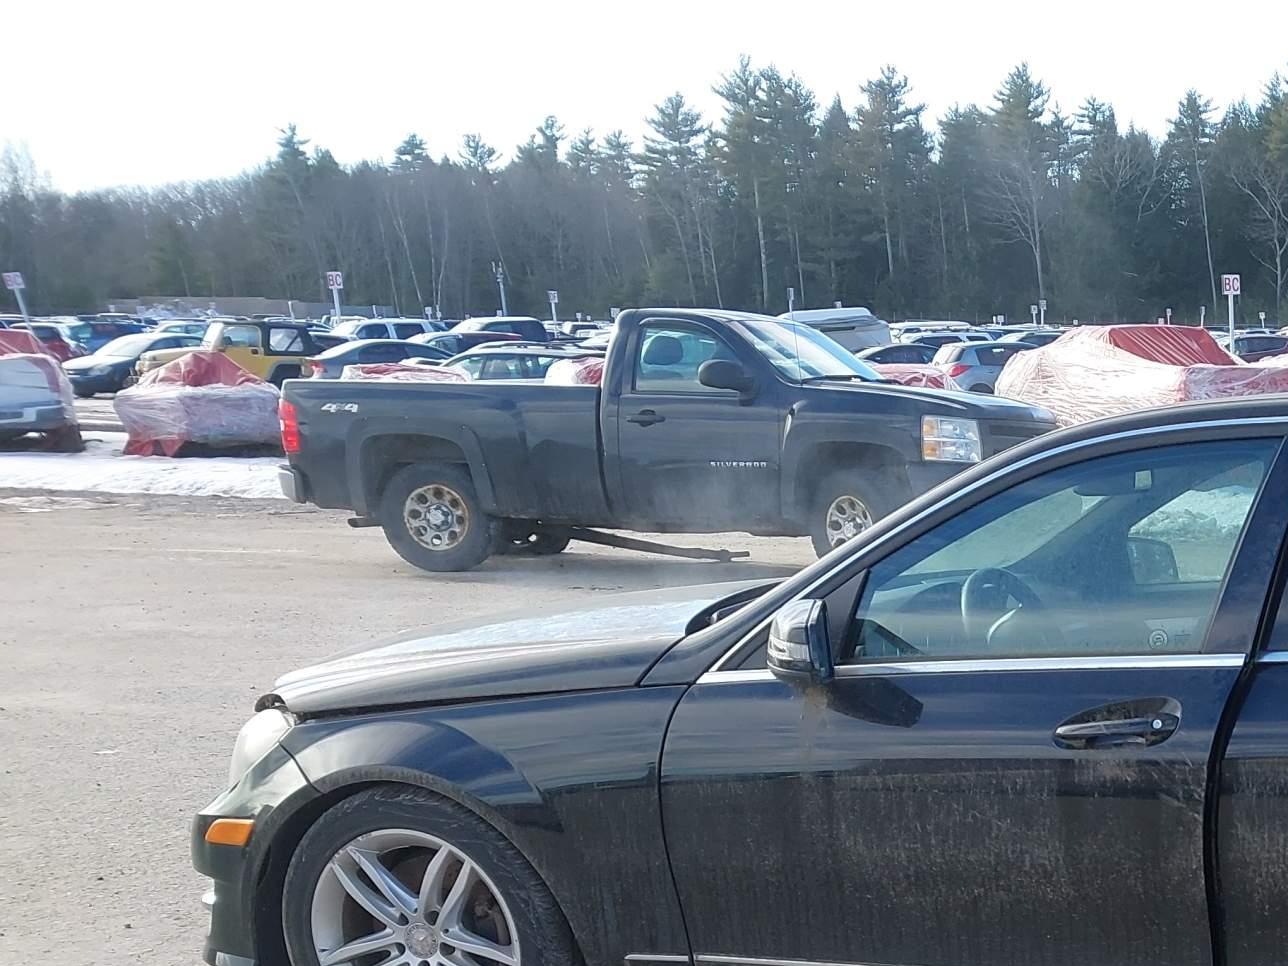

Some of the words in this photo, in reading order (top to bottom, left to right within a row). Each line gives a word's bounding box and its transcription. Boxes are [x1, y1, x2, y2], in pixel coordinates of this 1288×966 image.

[328, 274, 341, 287] BC
[1225, 277, 1239, 291] BC
[710, 460, 768, 469] SILVERADO
